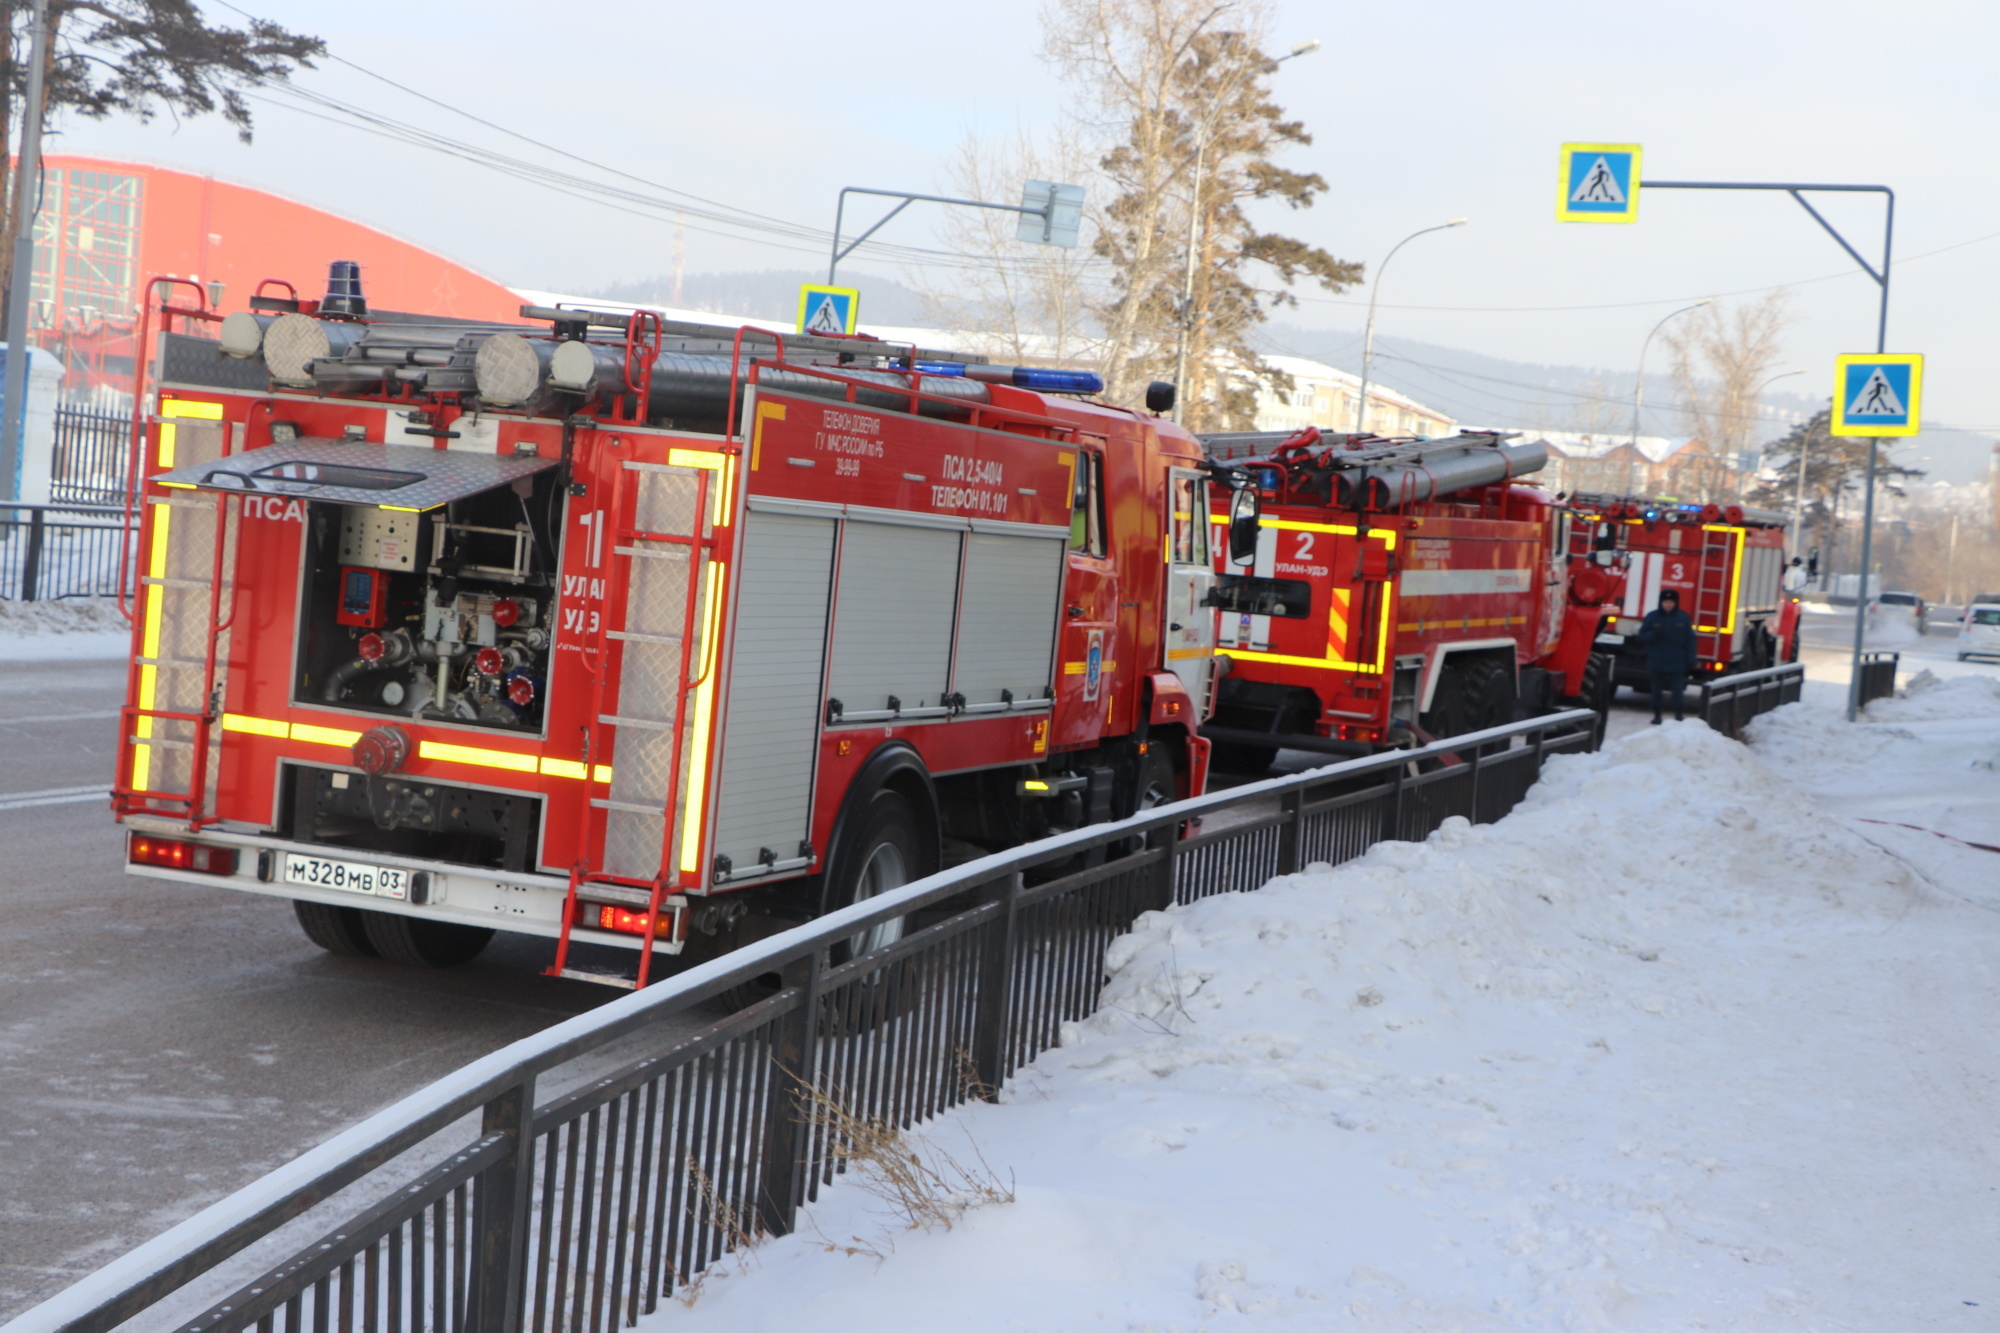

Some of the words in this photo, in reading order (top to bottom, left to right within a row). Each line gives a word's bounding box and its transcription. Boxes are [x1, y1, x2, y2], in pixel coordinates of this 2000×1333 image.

[943, 454, 965, 481] ПСА
[966, 458, 1003, 487] 2,5-40/4
[243, 495, 303, 523] ПСА
[932, 485, 979, 510] ТЕЛЕФОН
[980, 490, 1008, 515] 01,101
[1294, 532, 1315, 560] 2
[1275, 562, 1329, 577] УЛАН-УДЭ
[1670, 563, 1685, 580] 3
[380, 870, 400, 889] 03
